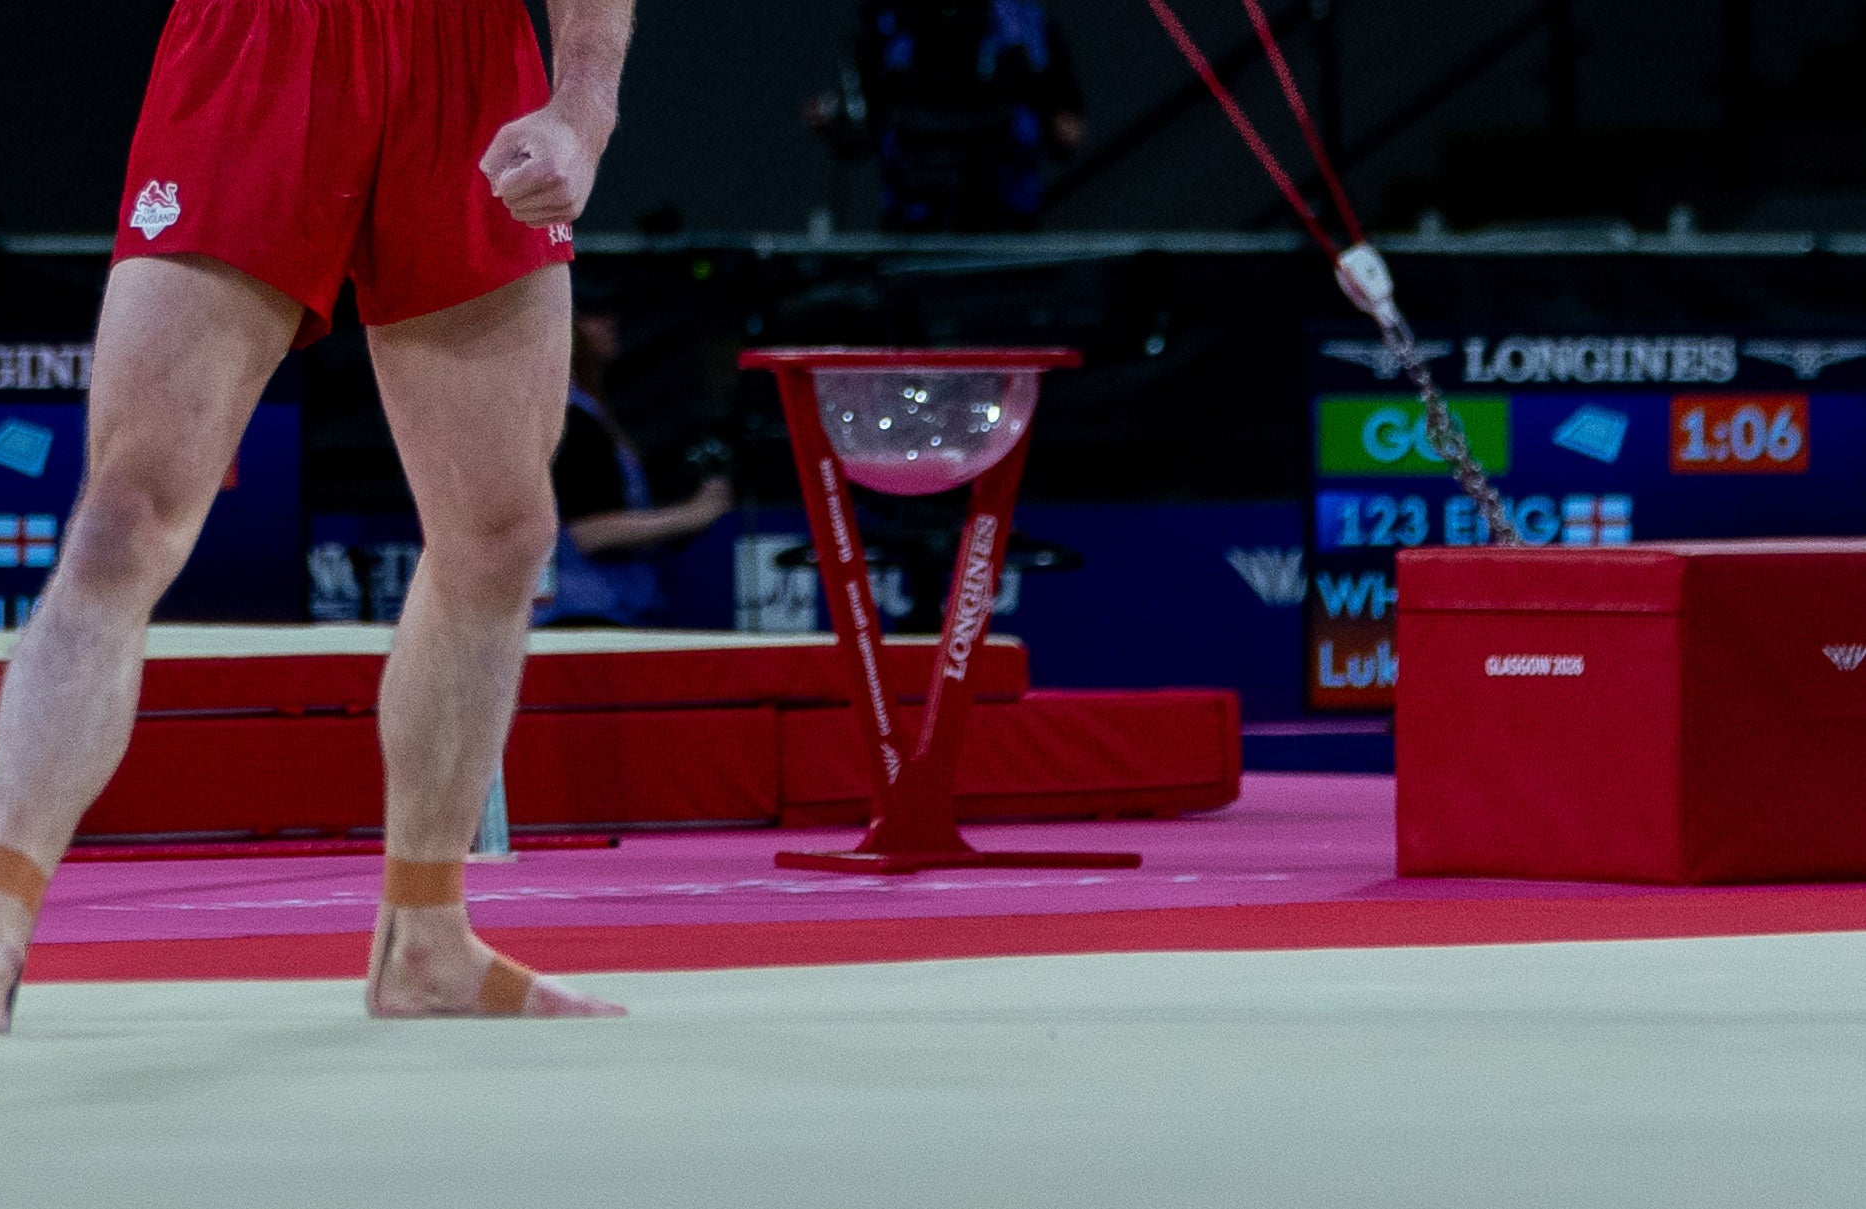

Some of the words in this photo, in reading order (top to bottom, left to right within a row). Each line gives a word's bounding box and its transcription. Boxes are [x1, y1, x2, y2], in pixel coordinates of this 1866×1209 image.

[1460, 336, 1738, 383] LONGINES
[1679, 405, 1803, 463] 1:06
[1337, 494, 1430, 546] 123
[943, 512, 998, 682] LONGINES
